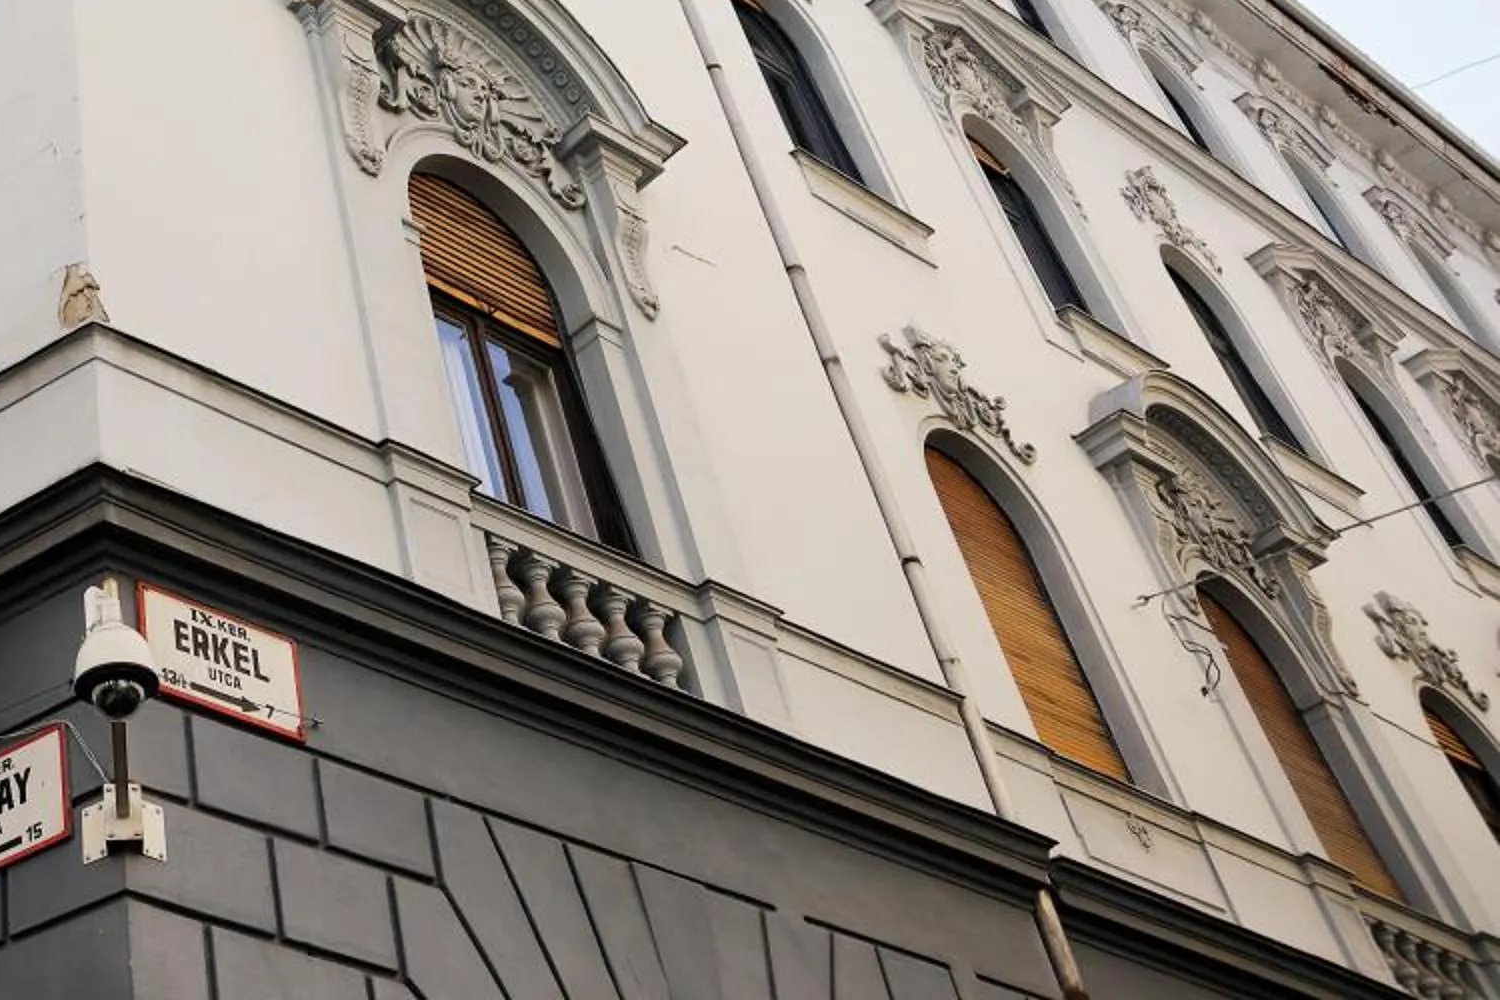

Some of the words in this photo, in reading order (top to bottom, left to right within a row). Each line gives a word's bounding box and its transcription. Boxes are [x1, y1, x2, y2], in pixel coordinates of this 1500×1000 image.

[217, 619, 251, 642] KER.
[173, 619, 271, 683] ERKEL
[208, 667, 242, 690] UTCA
[266, 703, 275, 718] 7
[26, 821, 43, 842] 15
